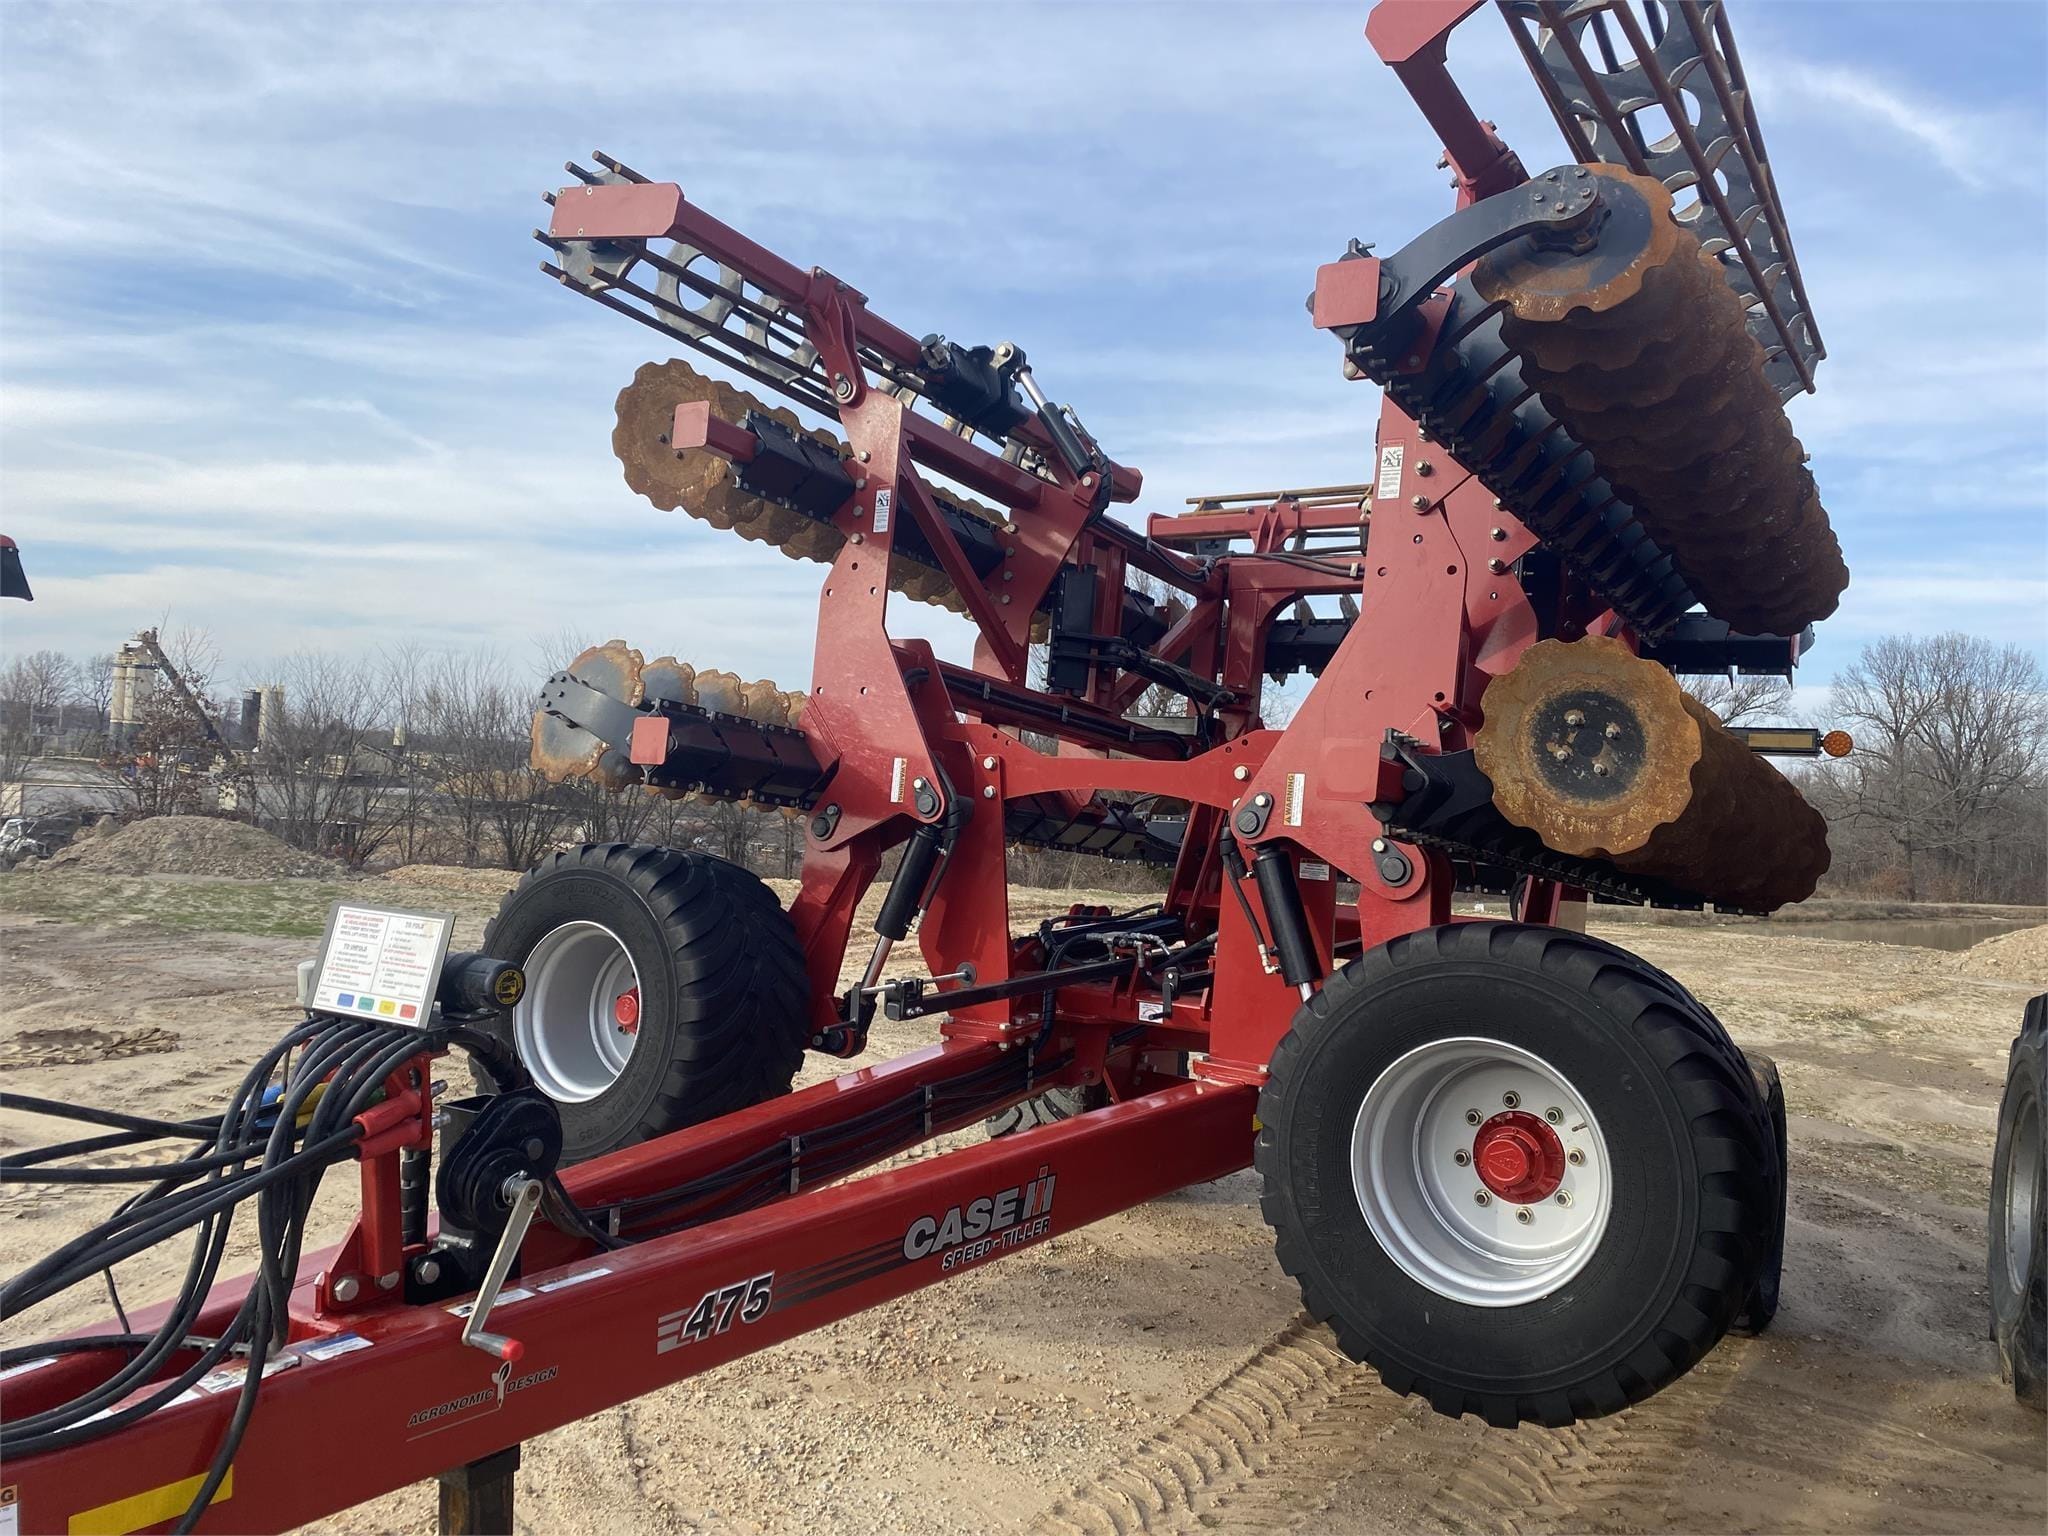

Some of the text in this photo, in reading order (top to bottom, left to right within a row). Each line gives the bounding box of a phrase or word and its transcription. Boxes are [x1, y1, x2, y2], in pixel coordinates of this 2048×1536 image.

[898, 768, 906, 801] WARNING
[1285, 775, 1295, 816] WARNING
[904, 1186, 1021, 1261] CASE
[942, 1216, 1052, 1272] SPEED-TILLER
[681, 1271, 775, 1344] 475
[407, 1365, 559, 1428] AGRONOMIC DESIGN
